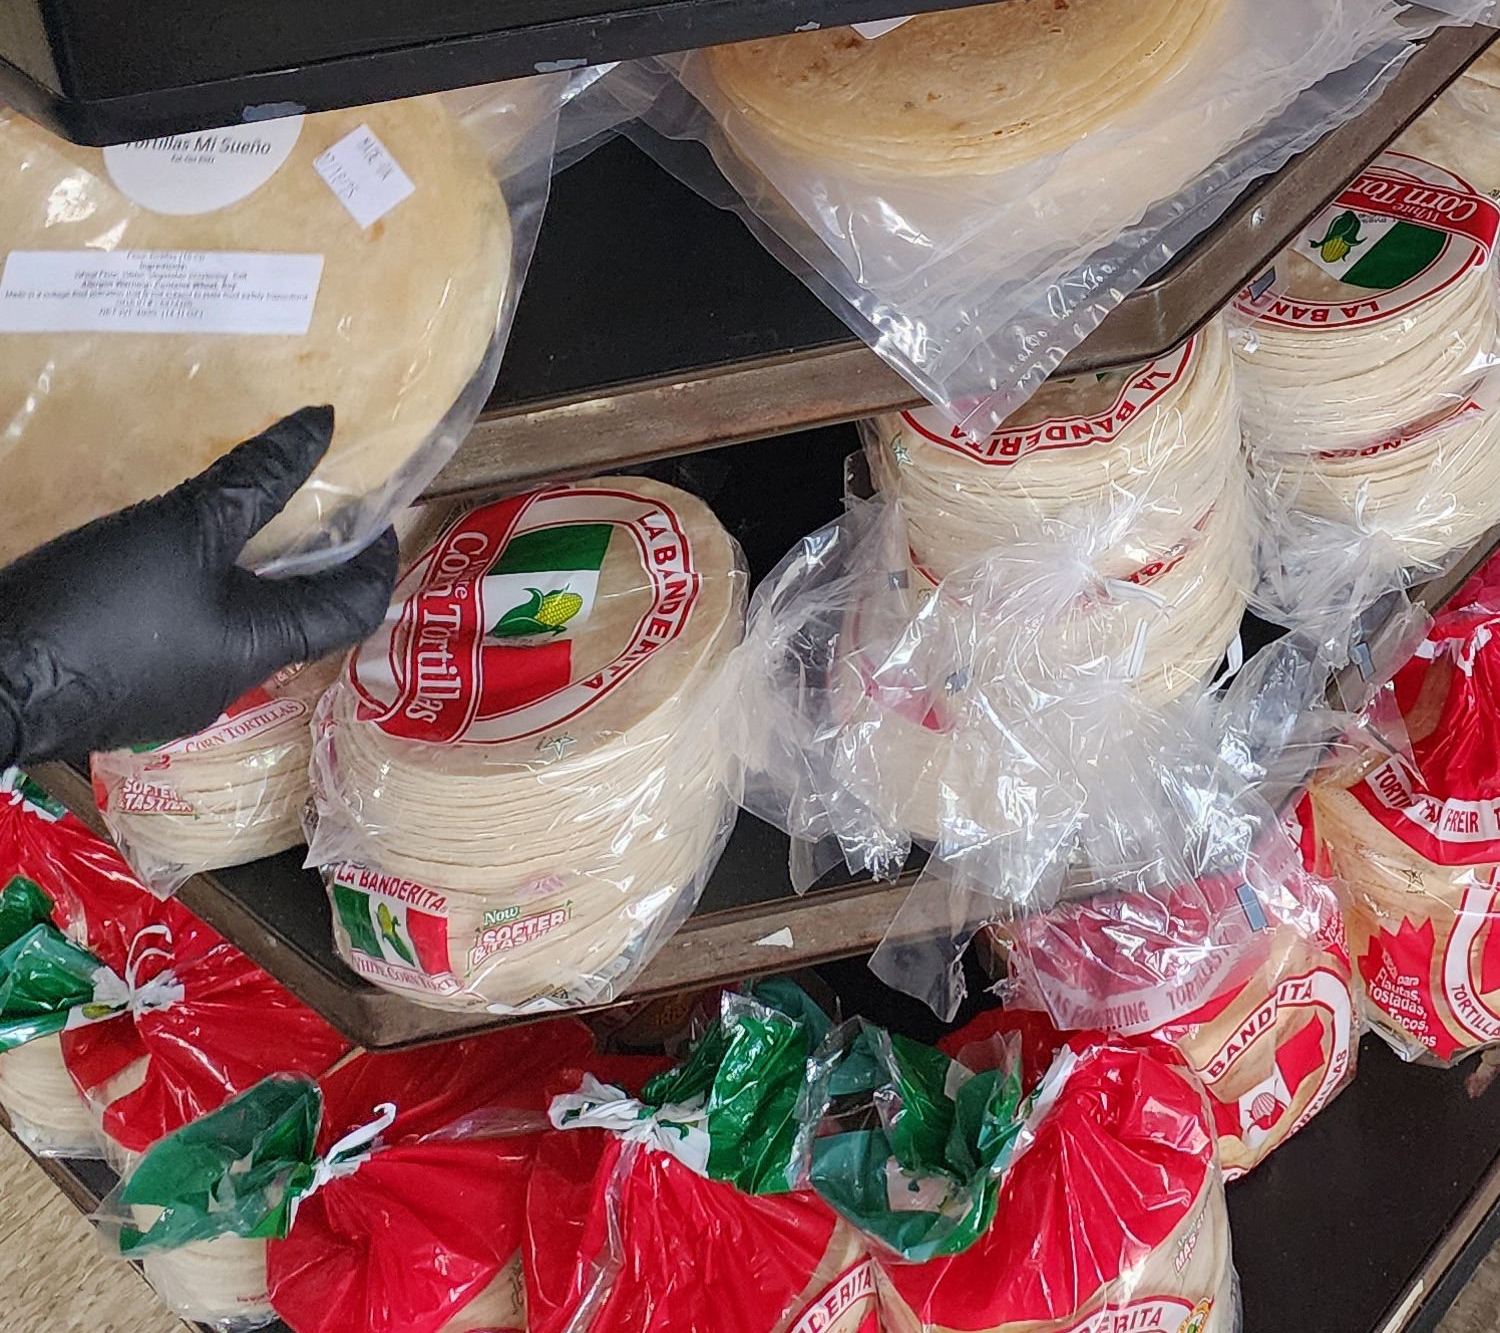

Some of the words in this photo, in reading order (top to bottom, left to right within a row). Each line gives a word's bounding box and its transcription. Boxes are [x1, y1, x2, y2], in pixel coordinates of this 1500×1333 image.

[1391, 202, 1441, 222] White
[1404, 186, 1479, 222] Corn
[1340, 299, 1380, 320] LA
[1132, 370, 1172, 393] LA
[949, 399, 1137, 458] BANDERITA
[637, 510, 667, 542] LA
[423, 531, 490, 599] Corn
[581, 544, 694, 690] BANDERITA
[405, 603, 462, 725] Tortillas
[185, 732, 226, 753] CORN
[223, 701, 300, 740] TORTILLAS
[335, 862, 356, 884] LA
[358, 868, 448, 912] BANDERITA
[481, 909, 568, 946] SOFTER
[483, 905, 521, 926] Now
[1368, 983, 1428, 1020] Tostadas,
[1375, 966, 1422, 1003] Flautas,
[1387, 1007, 1430, 1033] Tacos,
